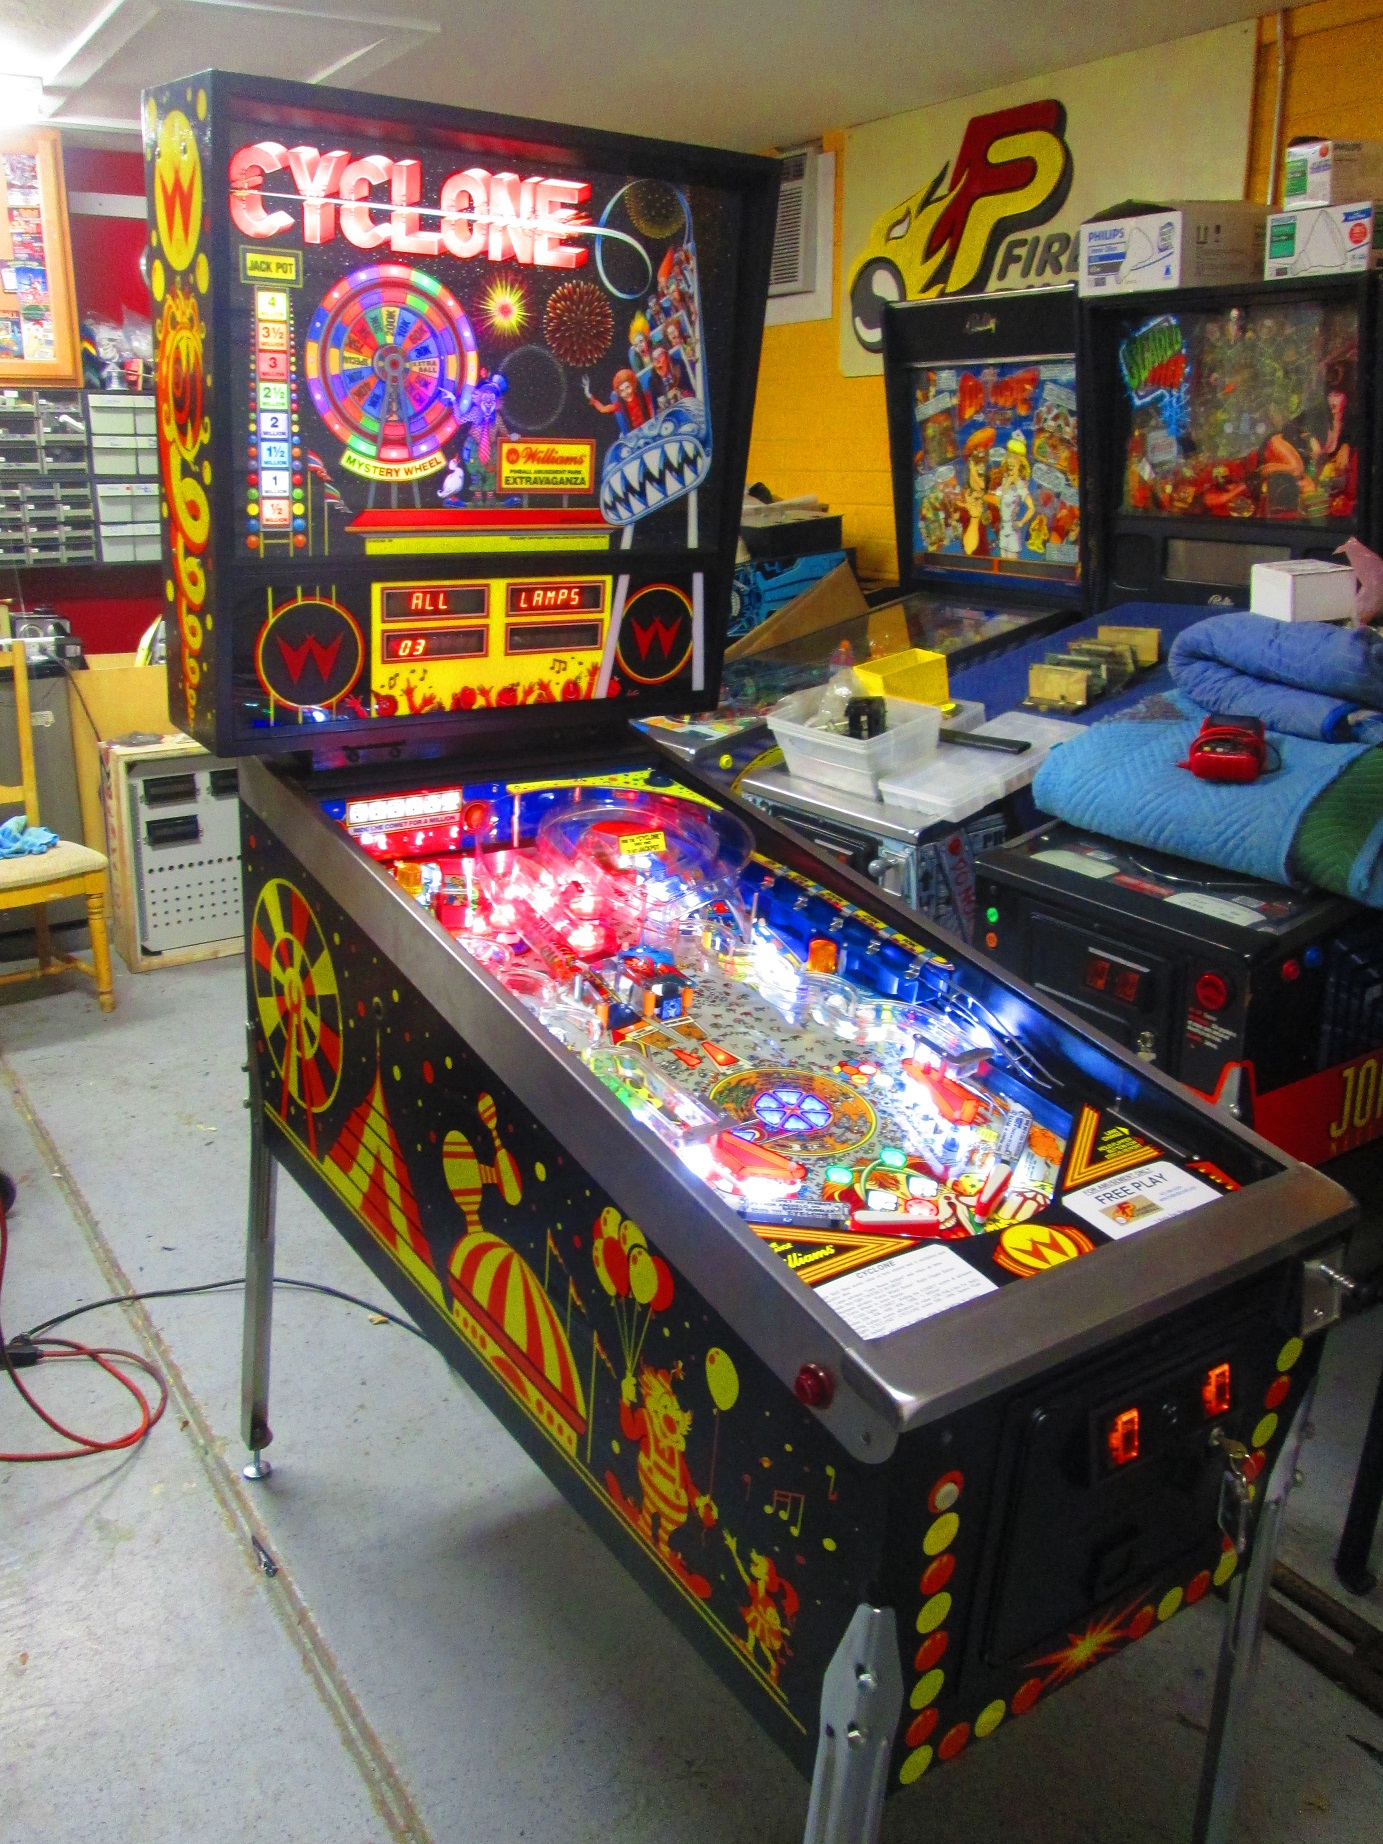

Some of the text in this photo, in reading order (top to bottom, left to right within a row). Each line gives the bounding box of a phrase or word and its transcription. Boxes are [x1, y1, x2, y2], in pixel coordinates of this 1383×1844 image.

[228, 141, 591, 268] CYCLONE
[1088, 227, 1125, 243] PHILIPS
[248, 259, 294, 274] JACK POT
[268, 296, 276, 308] 4
[268, 357, 277, 369] 3
[270, 416, 279, 429] 2
[345, 453, 442, 477] MYSTERY WHEEL
[272, 475, 278, 487] 1
[504, 475, 587, 486] EXTRAVAGANZA
[411, 592, 448, 611] ALL
[519, 588, 580, 608] LAMPS
[398, 638, 426, 656] 03
[409, 819, 422, 827] FOR
[1094, 1185, 1135, 1205] FREE
[1130, 1172, 1169, 1192] PLAY
[783, 1244, 835, 1269] lliams
[856, 1259, 897, 1279] CYCLONE
